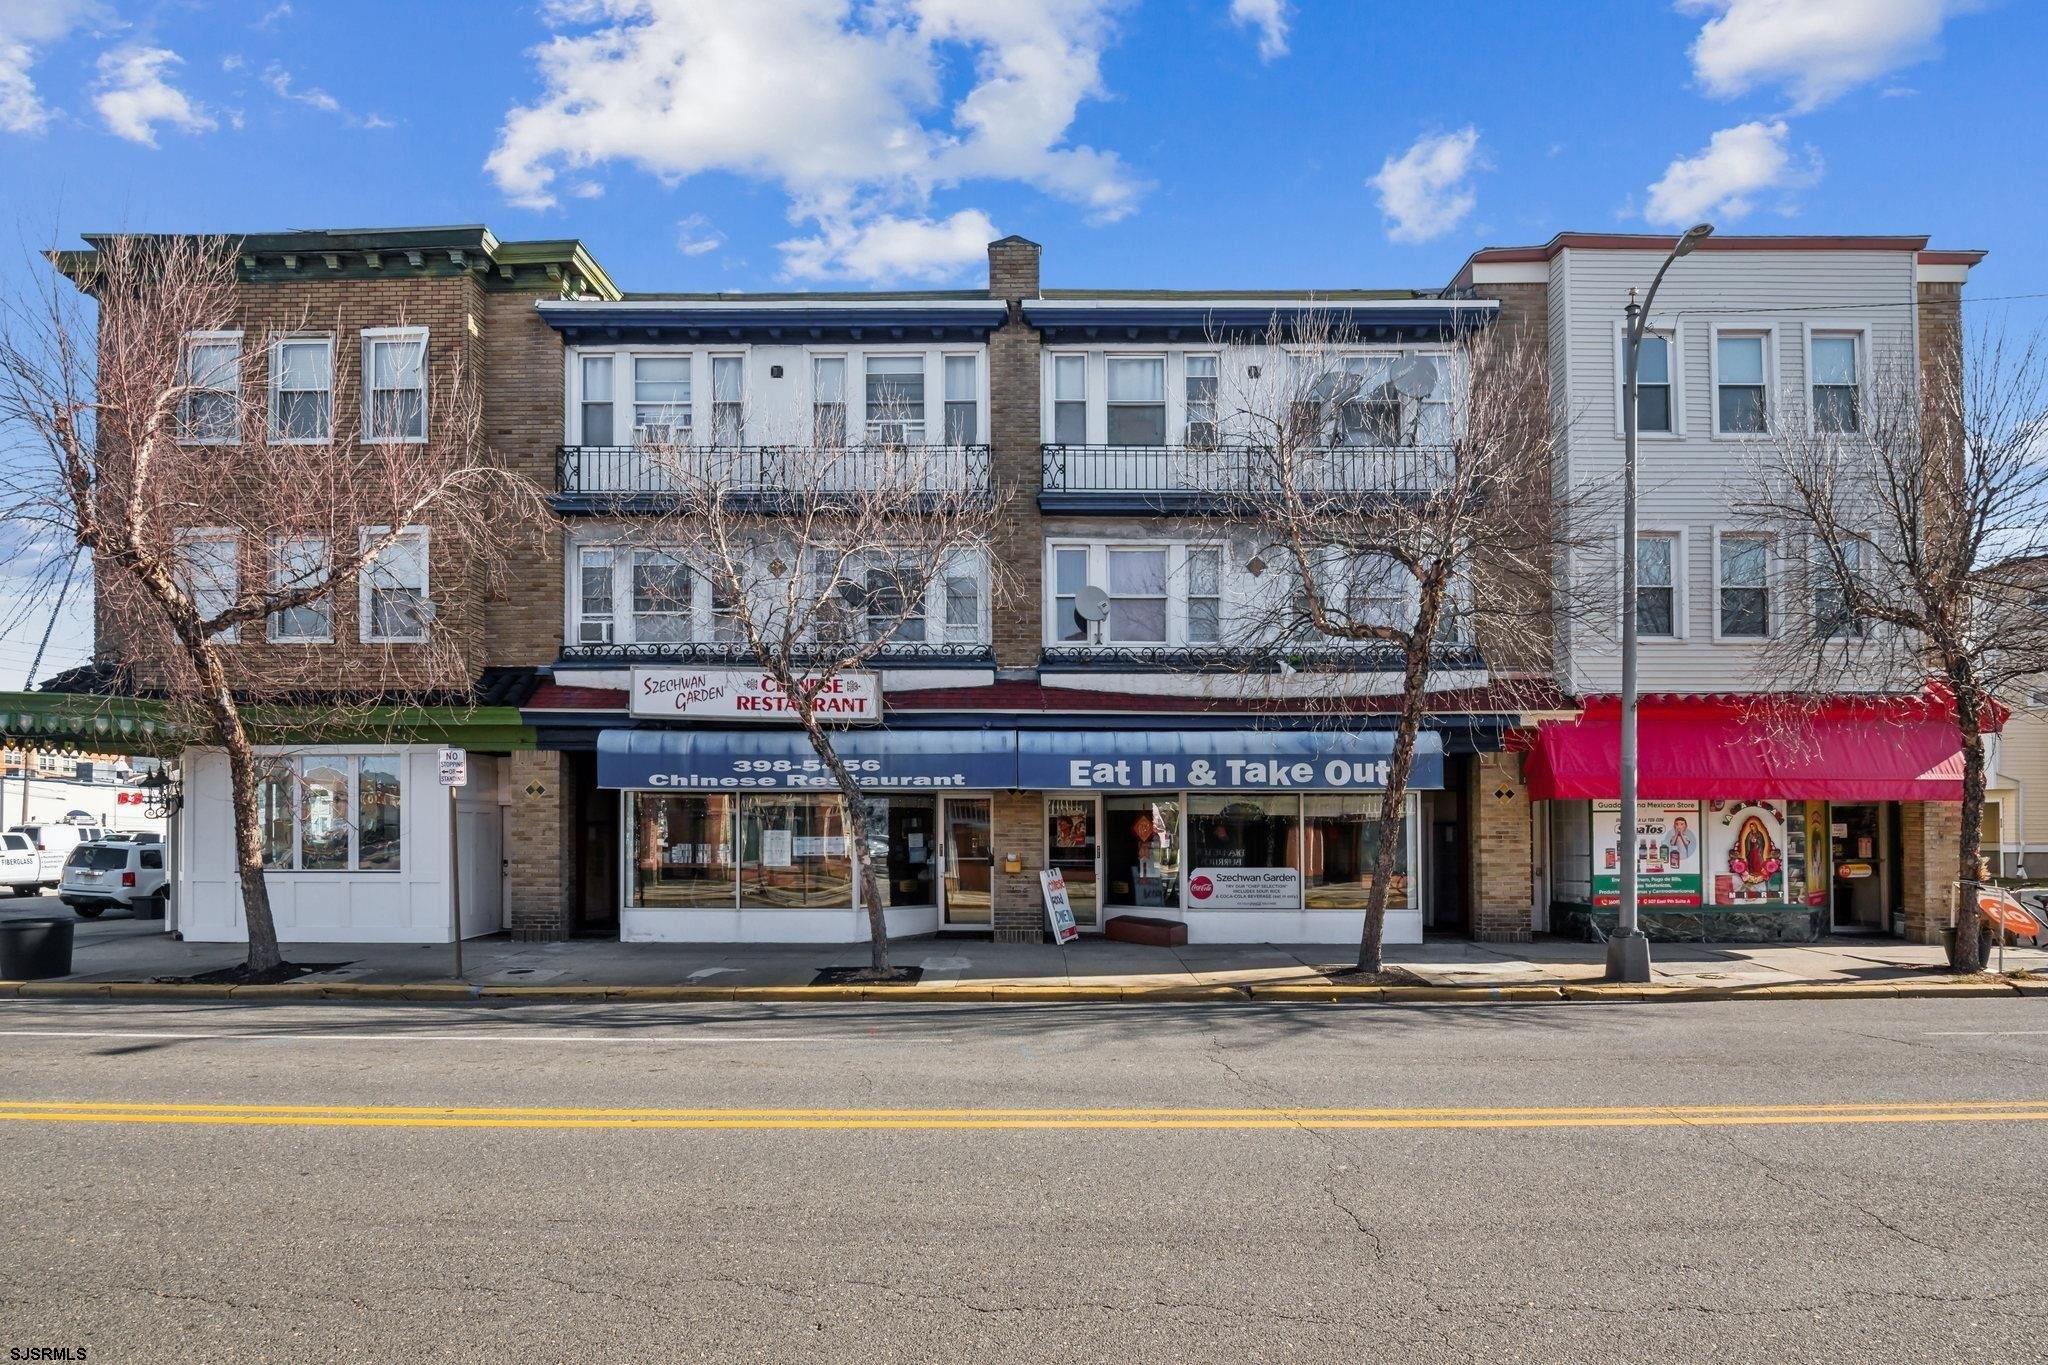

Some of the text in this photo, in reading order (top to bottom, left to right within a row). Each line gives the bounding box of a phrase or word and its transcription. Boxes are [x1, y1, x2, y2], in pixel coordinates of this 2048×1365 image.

[643, 674, 706, 696] SZECHWAN
[675, 685, 724, 712] GARDEN
[736, 695, 868, 713] RESTARANT
[446, 752, 458, 760] NO
[1069, 759, 1391, 786] Eat In & Take Out
[648, 773, 777, 787] Chinese
[1647, 801, 1676, 809] Mexican
[1677, 801, 1695, 809] Store
[1, 858, 33, 866] FIBERGLASS
[1216, 873, 1297, 882] Szechwan Garden
